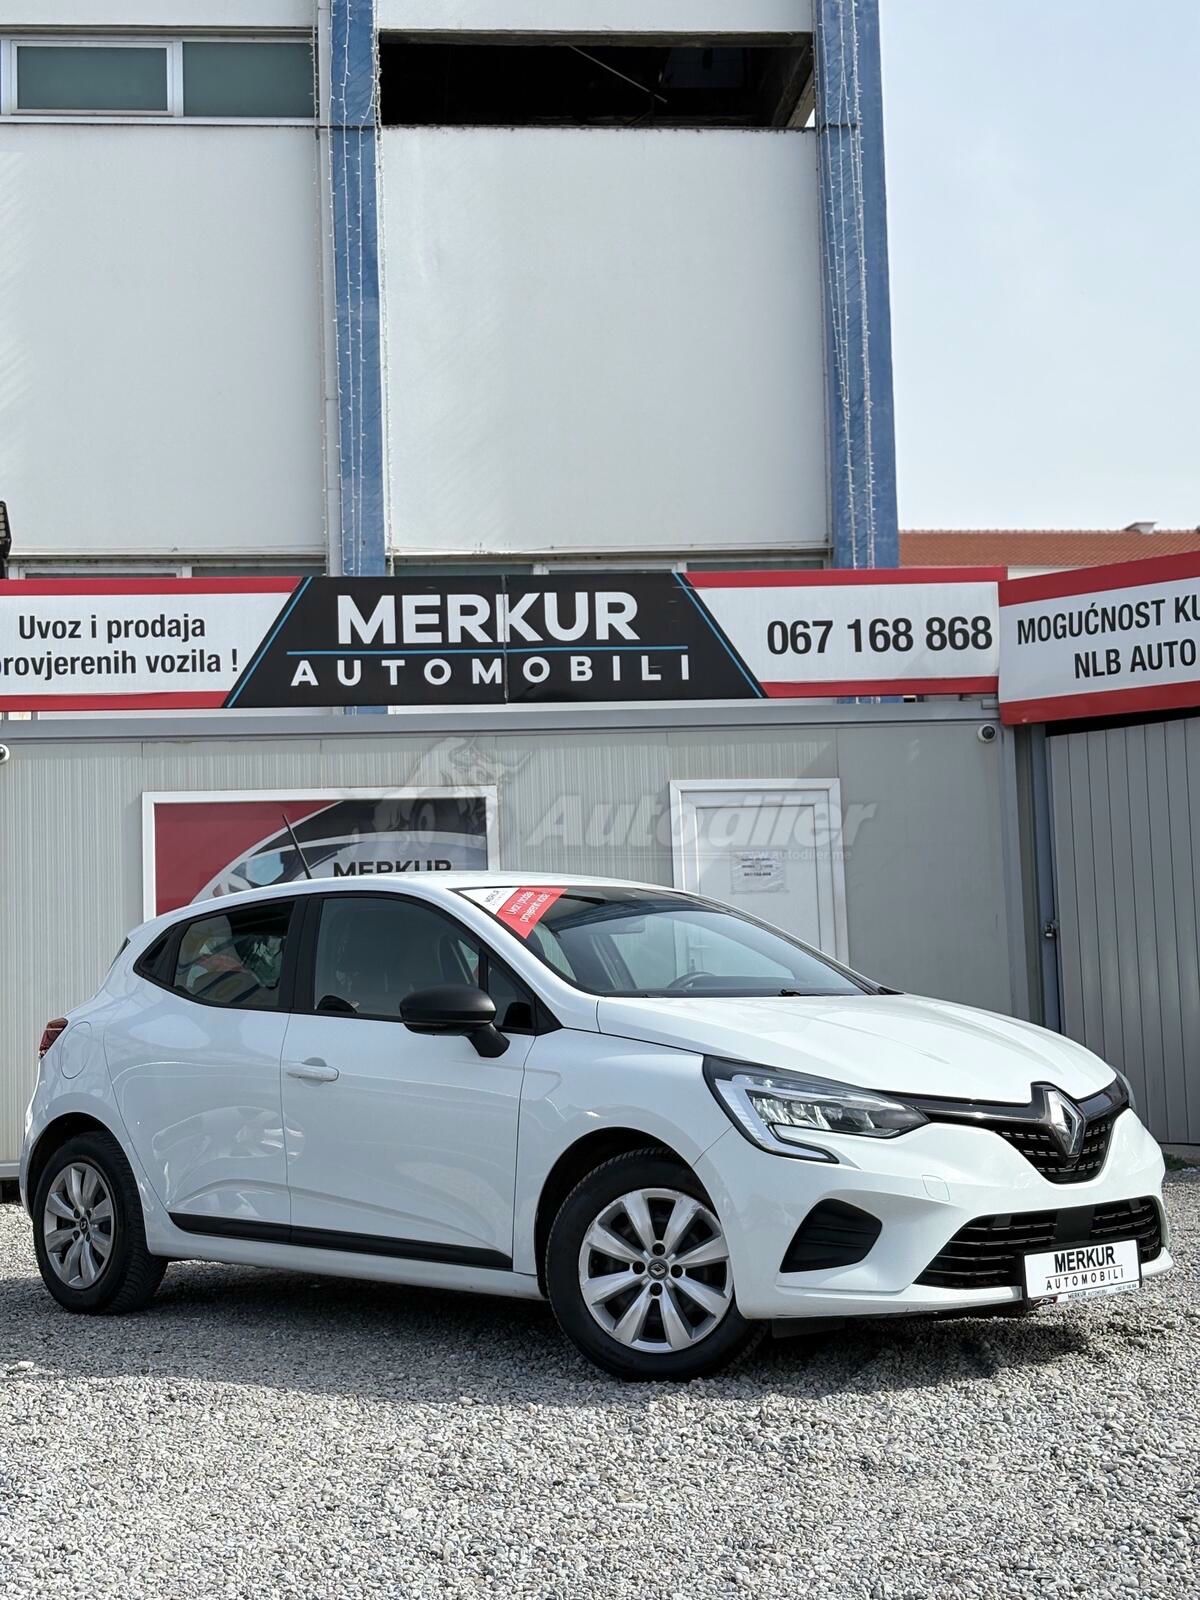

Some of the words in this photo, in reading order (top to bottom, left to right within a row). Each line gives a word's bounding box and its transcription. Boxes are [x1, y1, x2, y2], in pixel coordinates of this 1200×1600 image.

[19, 615, 82, 640] Uvoz
[91, 614, 97, 638] i
[107, 613, 206, 644] prodaja
[337, 591, 641, 645] MERKUR
[1016, 598, 1166, 645] MOGUĆNOST
[767, 619, 834, 655] 067
[847, 617, 914, 653] 168
[925, 615, 993, 650] 868
[0, 649, 137, 681] rovjerenih
[146, 648, 222, 674] vozila
[231, 648, 239, 672] !
[290, 654, 690, 687] AUTOMOBILI
[1074, 647, 1121, 679] NLB
[1130, 638, 1197, 674] AUTO
[1054, 1245, 1115, 1273] MERKUR
[1046, 1267, 1124, 1291] AUTOMOBILI
